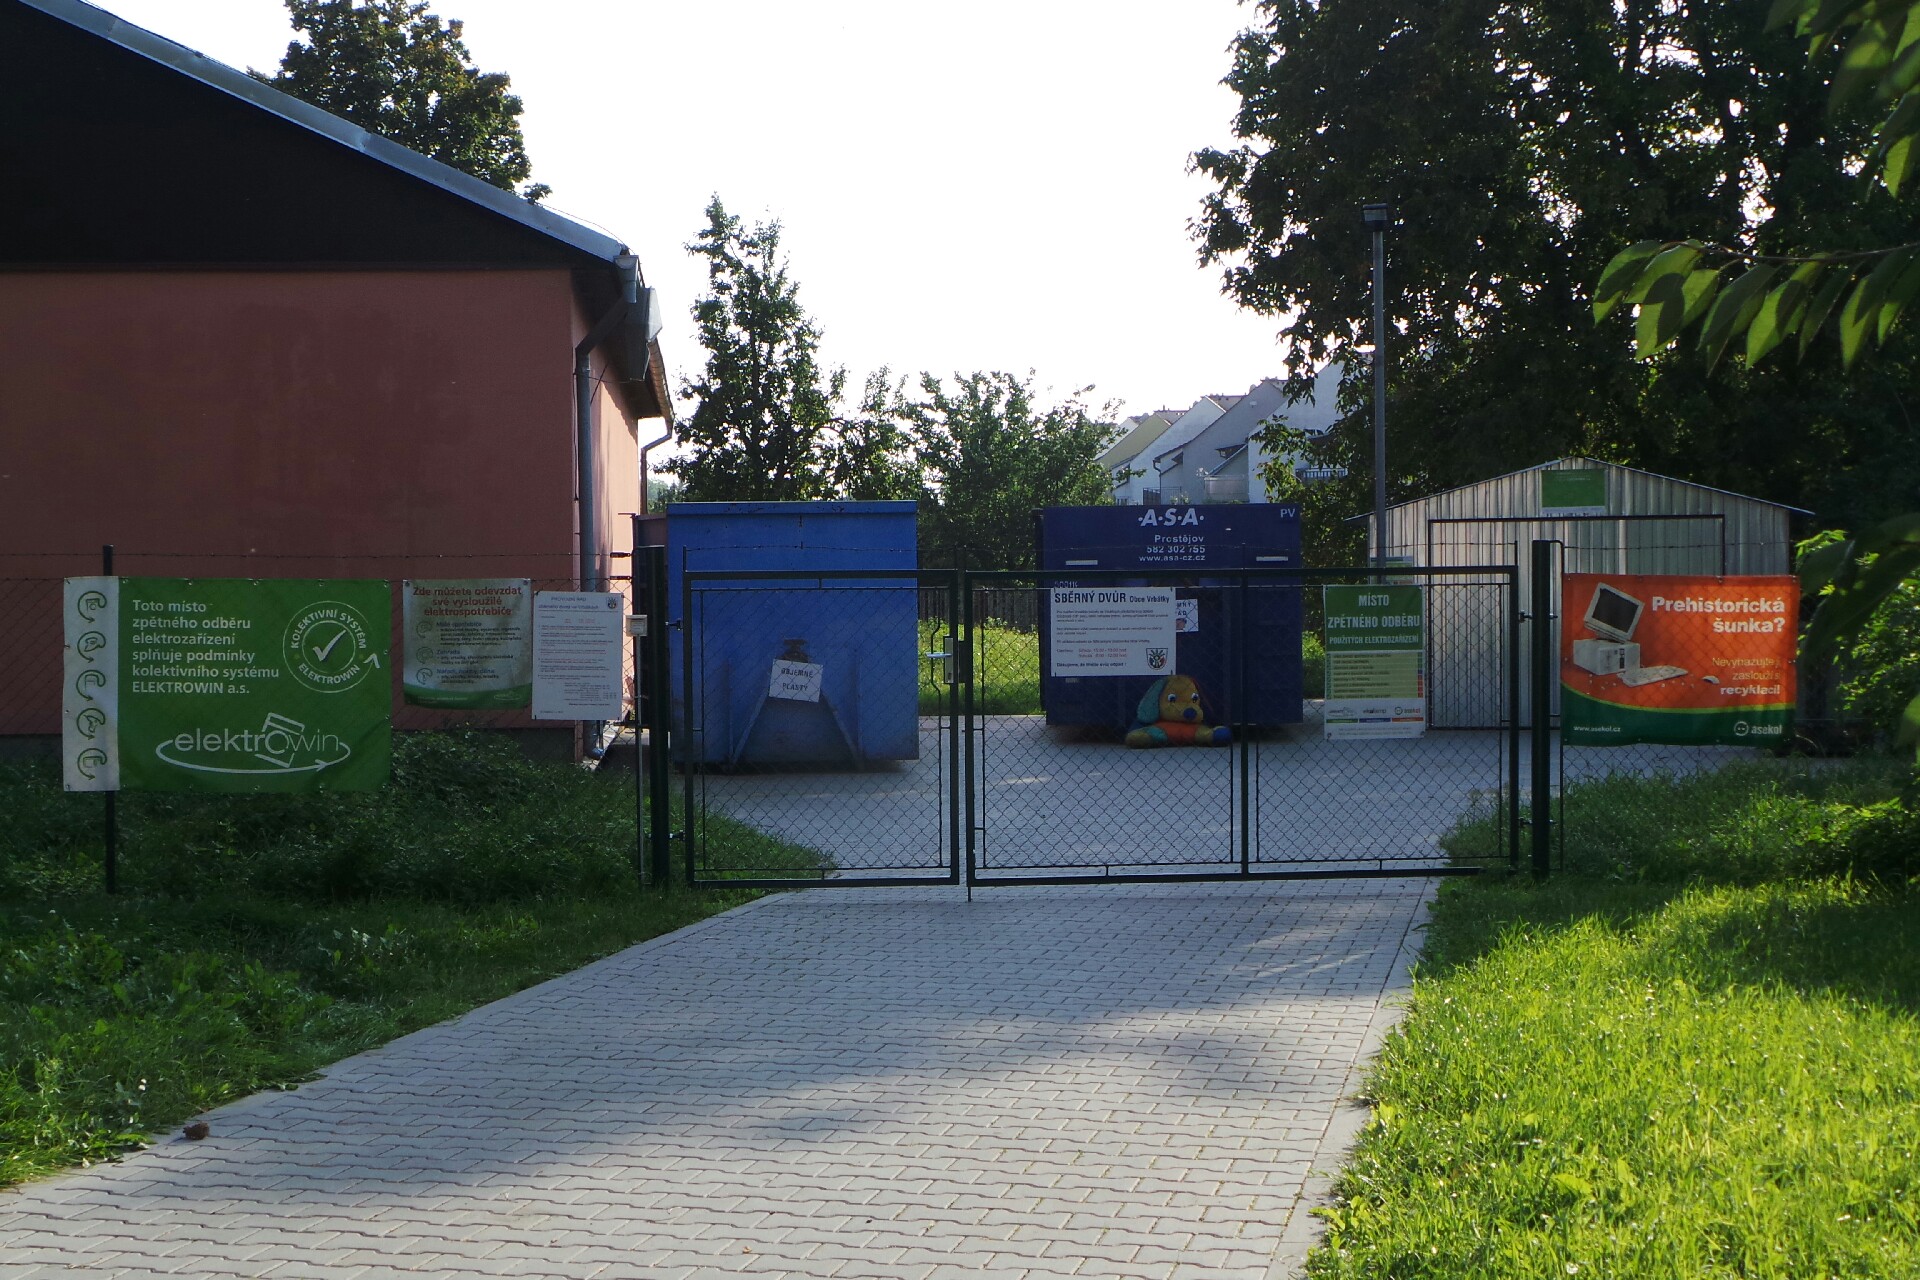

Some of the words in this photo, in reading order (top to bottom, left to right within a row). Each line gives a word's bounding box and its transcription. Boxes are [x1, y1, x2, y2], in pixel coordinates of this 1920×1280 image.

[1280, 508, 1296, 518] PV
[1154, 534, 1204, 545] Prostějov
[1167, 545, 1186, 554] 302
[1138, 553, 1206, 562] www.asa-cz.cz
[412, 587, 432, 596] Zde
[434, 586, 472, 596] můžete
[474, 586, 522, 596] odevzdat
[1054, 590, 1096, 604] SBĚRNÝ
[1098, 590, 1126, 603] DVŮR
[432, 597, 449, 606] své
[452, 596, 503, 608] vysloužilé
[1358, 592, 1390, 607] MÍSTO
[1651, 596, 1786, 613] Prehistorická
[133, 600, 164, 612] Toto
[168, 600, 207, 613] místo
[424, 606, 512, 618] elektrospotřebiče
[132, 616, 198, 631] zpětného
[201, 616, 251, 629] odběru
[1327, 613, 1378, 629] ZPĚTNÉHO
[1381, 613, 1420, 628] ODBĚRU
[1712, 617, 1786, 634] šunka?
[290, 609, 338, 649] KOLEKTIVNÍ
[339, 612, 367, 649] SYSTÉM
[132, 632, 236, 645] elektrozařízení
[132, 648, 182, 663] splňuje
[186, 650, 256, 664] podmínky
[132, 665, 219, 678] kolektivního
[222, 666, 280, 681] systému
[298, 662, 361, 685] ELEKTROWIN
[132, 681, 224, 694] ELEKTROWIN
[227, 684, 250, 694] a.s.
[783, 682, 808, 691] PLASTY
[1720, 685, 1781, 697] recyklaci!
[1751, 724, 1783, 734] asekol
